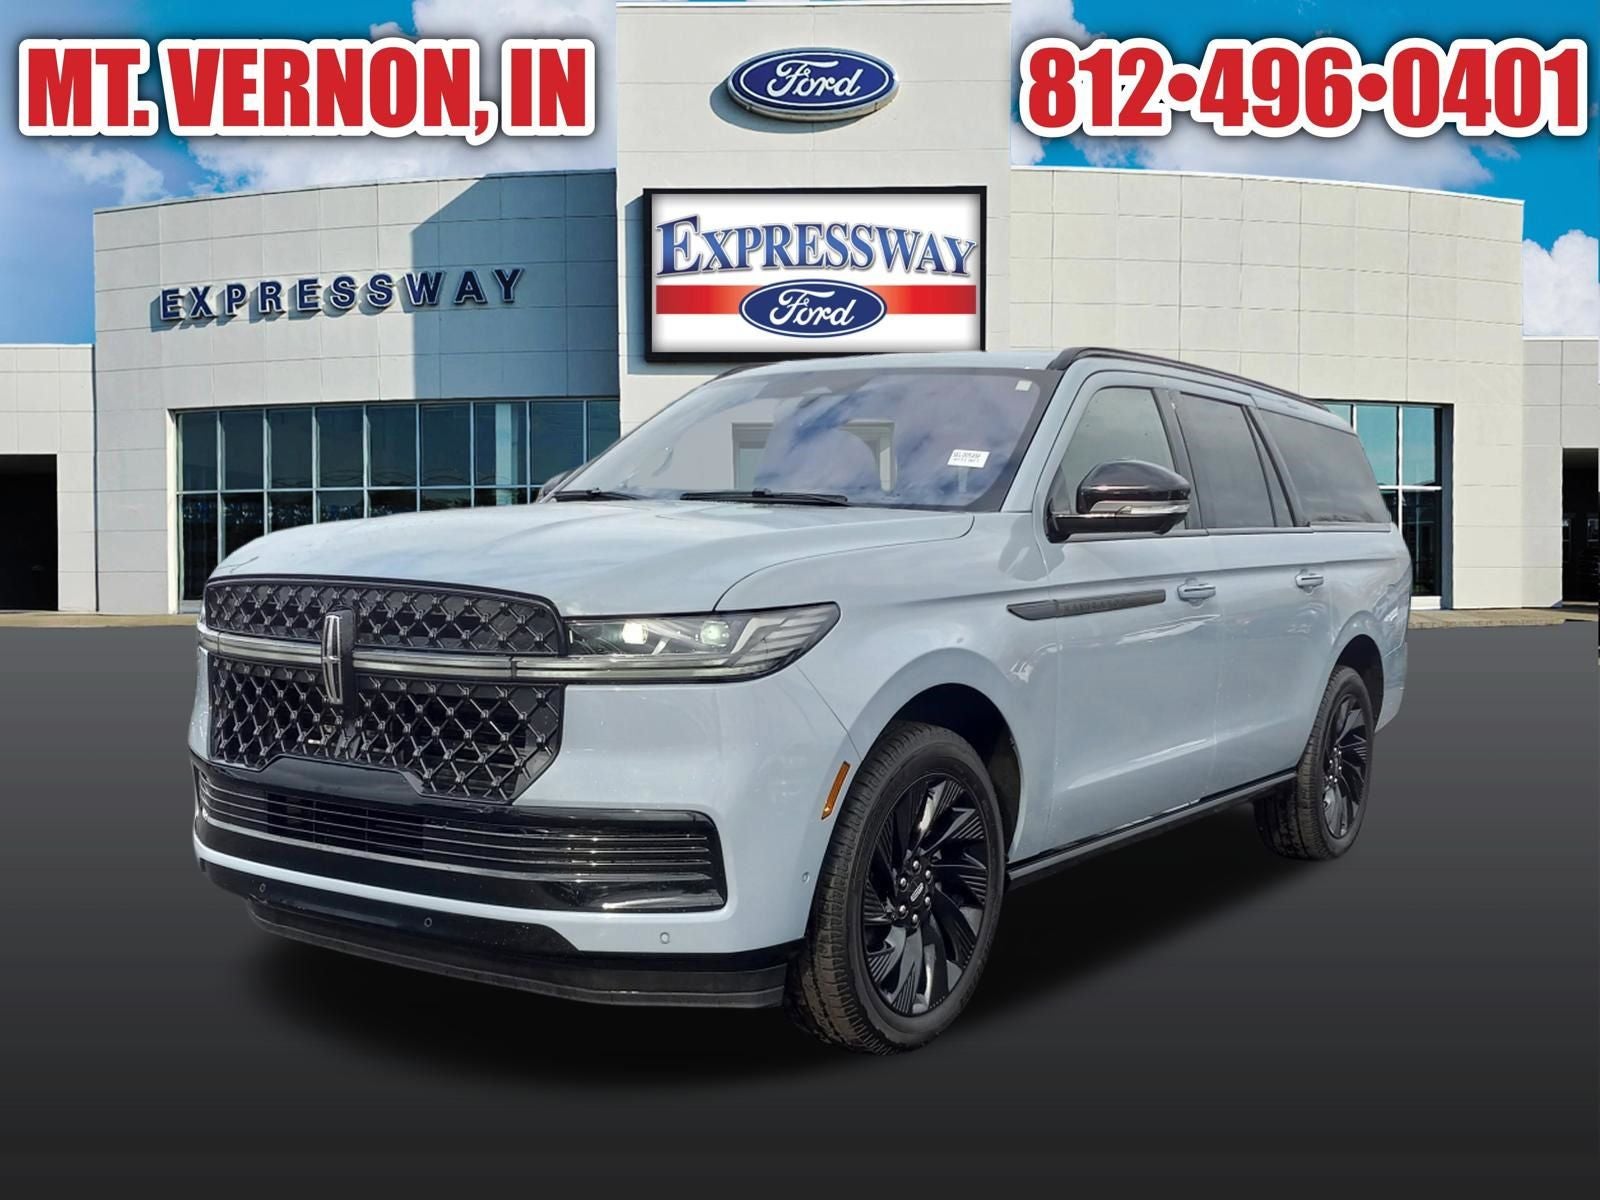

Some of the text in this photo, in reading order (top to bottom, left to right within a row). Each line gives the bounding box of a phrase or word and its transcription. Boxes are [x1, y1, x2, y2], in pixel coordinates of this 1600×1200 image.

[767, 59, 864, 97] Ford
[160, 268, 523, 321] EXPRESSWAY
[769, 288, 857, 326] Ford
